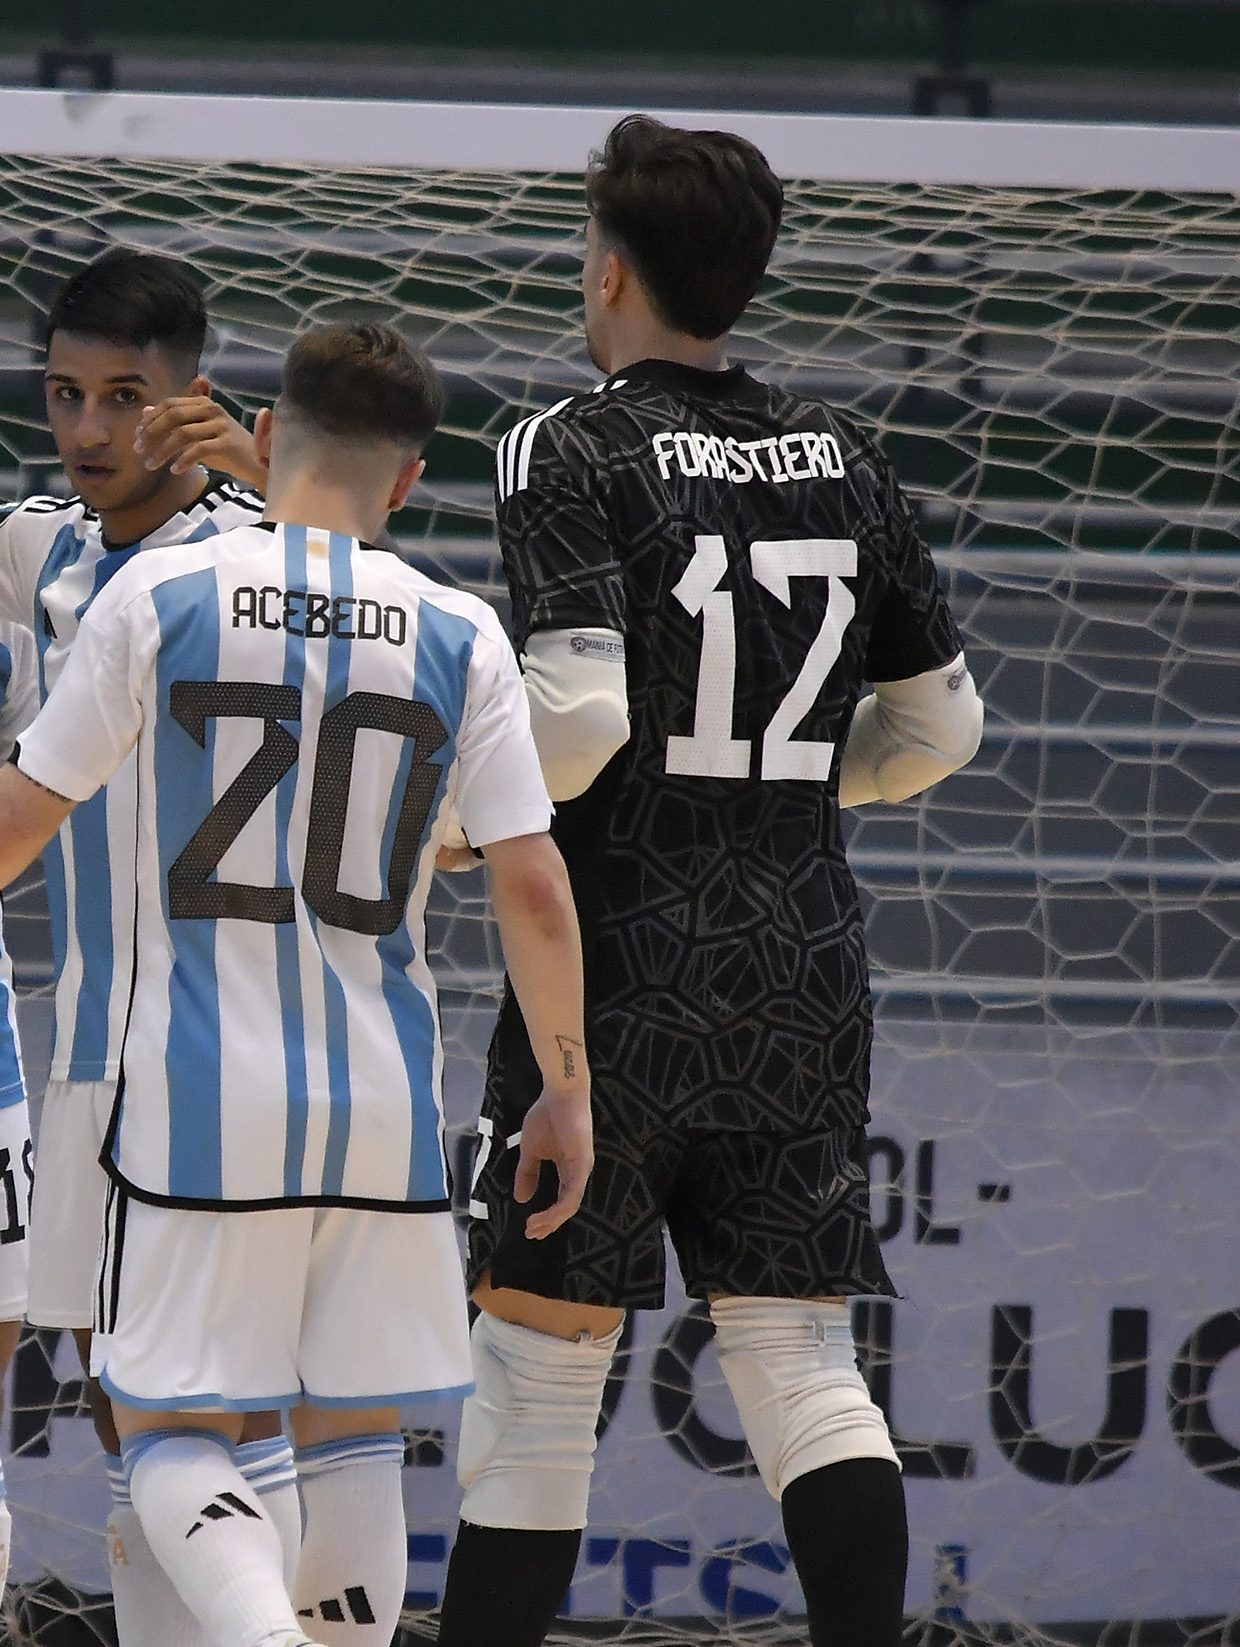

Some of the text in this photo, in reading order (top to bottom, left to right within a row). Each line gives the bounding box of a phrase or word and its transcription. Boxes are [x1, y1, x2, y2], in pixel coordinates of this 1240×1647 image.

[653, 431, 846, 484] FORASTIERO
[231, 585, 407, 647] ACEBEDO
[664, 534, 858, 781] 12
[167, 680, 449, 937] 20
